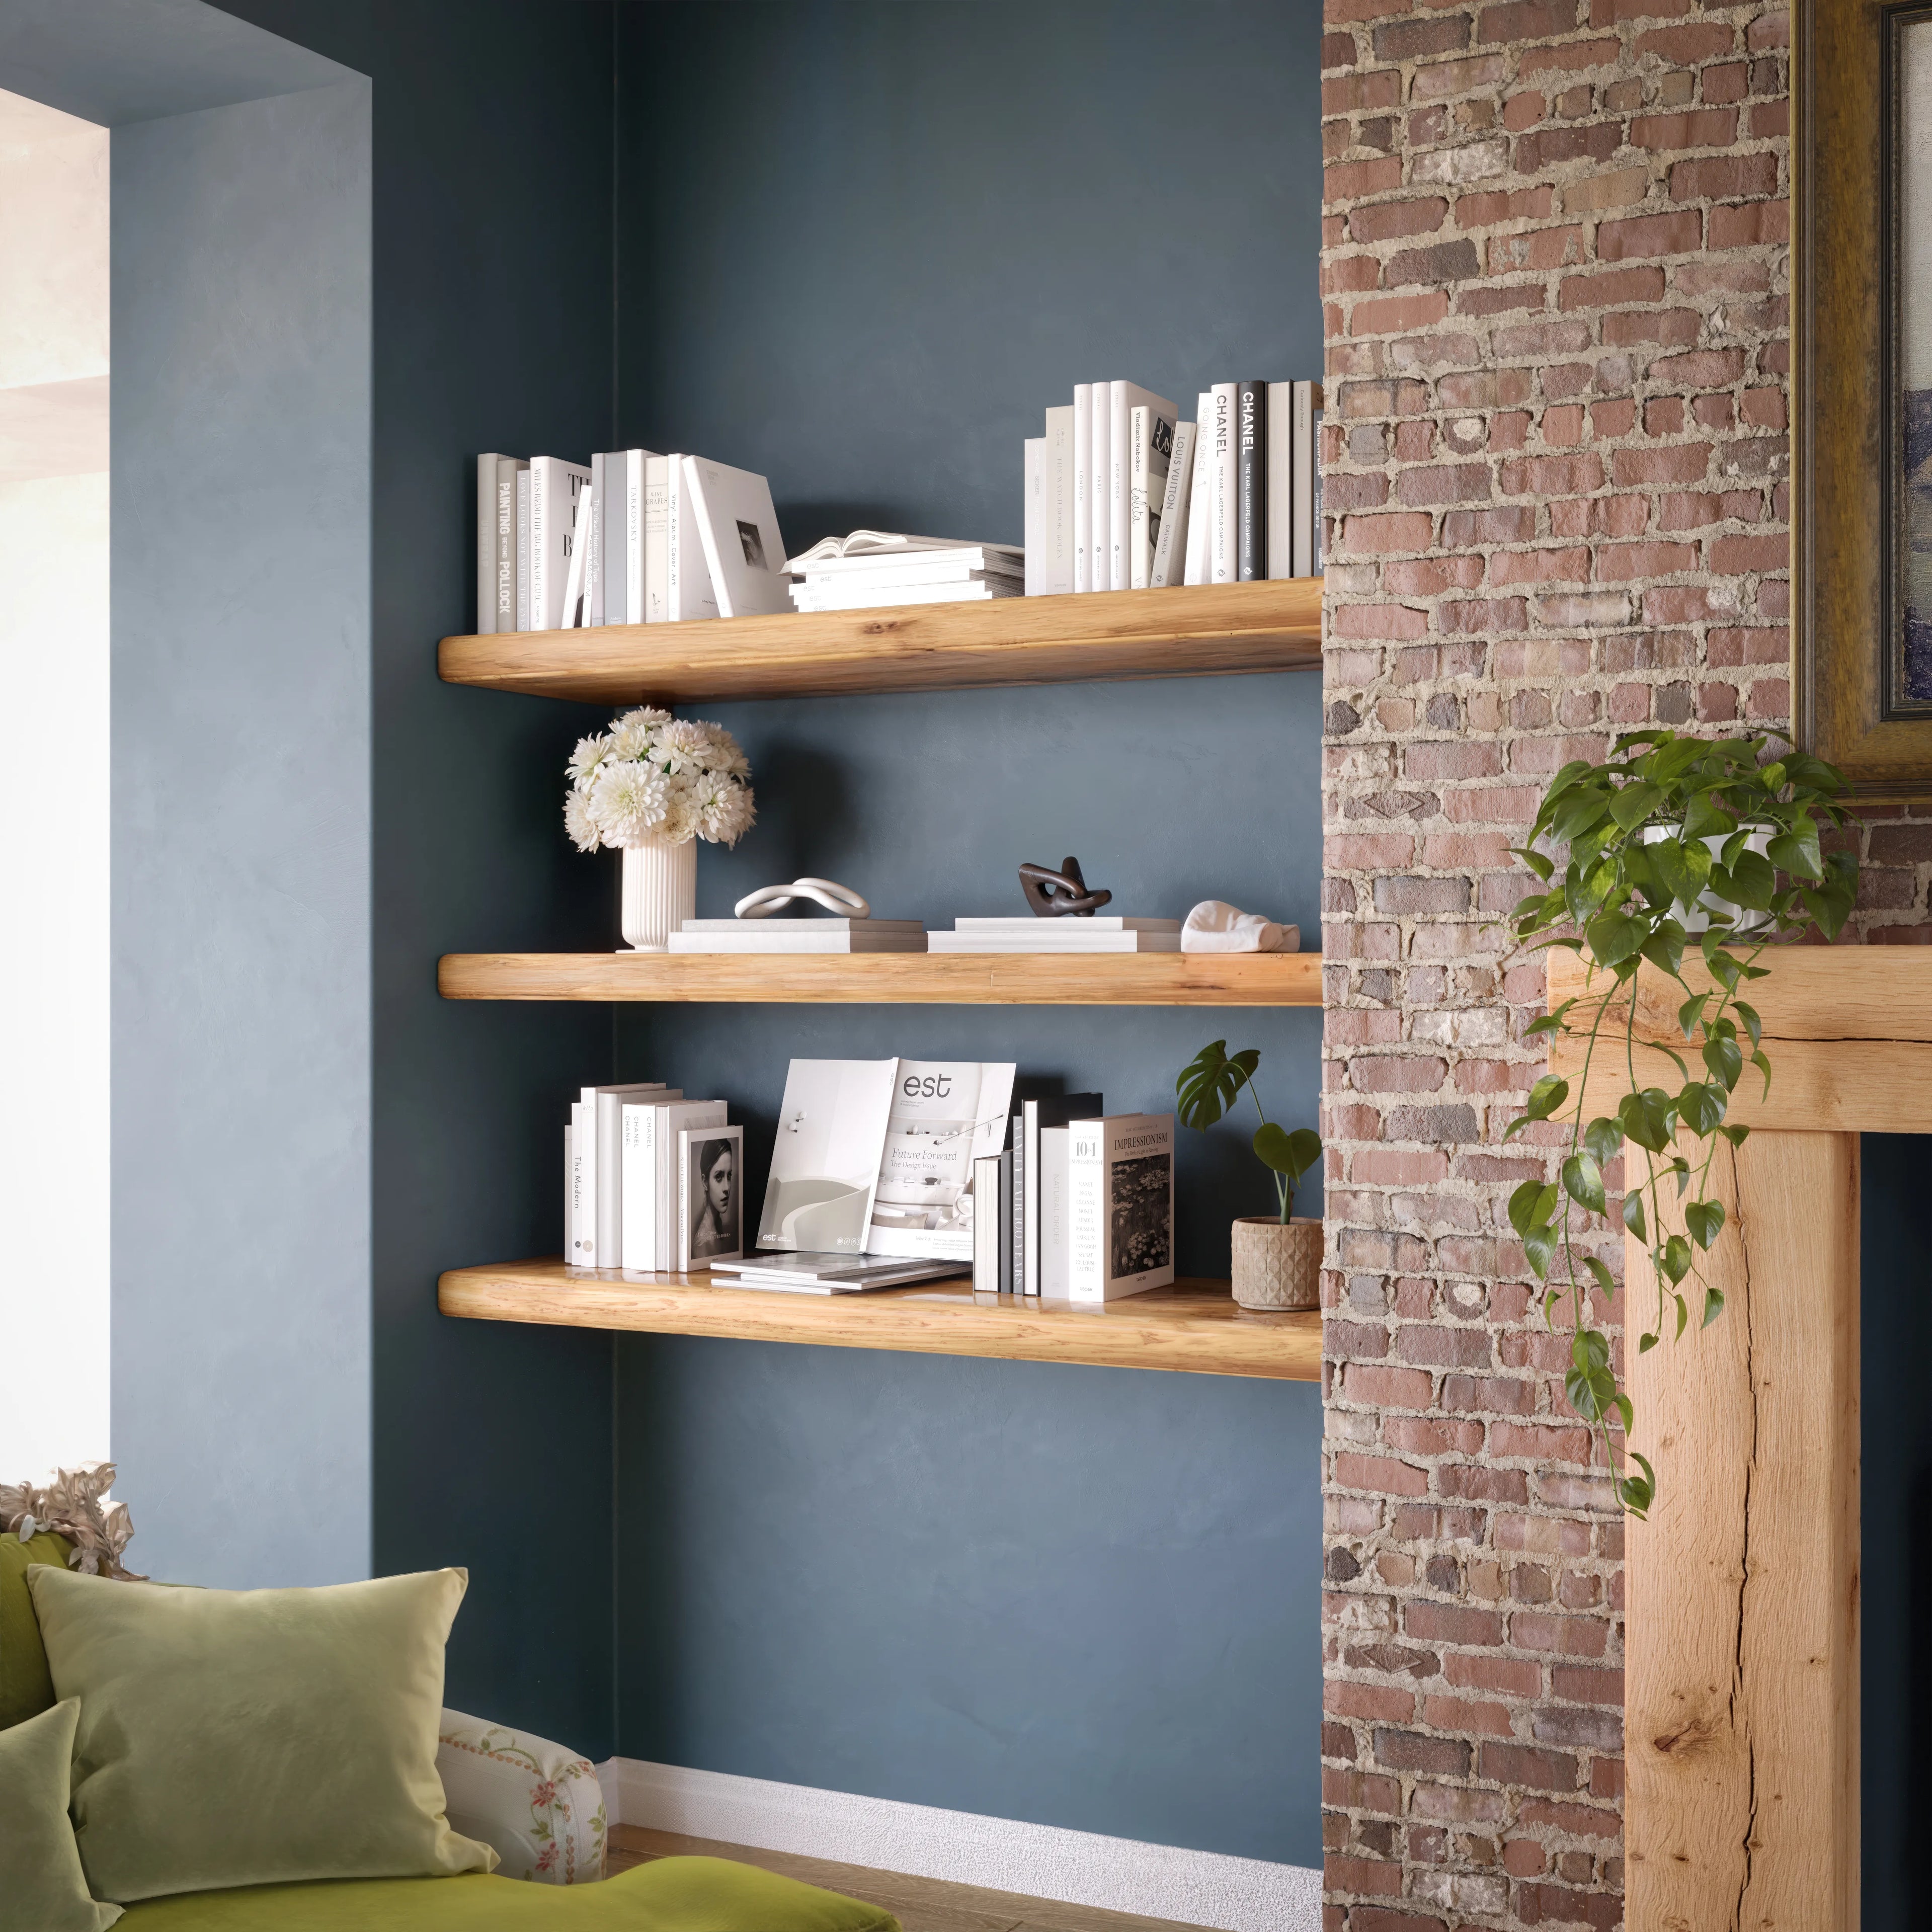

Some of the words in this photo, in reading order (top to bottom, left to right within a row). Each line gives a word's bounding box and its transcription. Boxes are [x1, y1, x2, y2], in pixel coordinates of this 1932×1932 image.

[1157, 421, 1175, 452] Lol
[1201, 408, 1209, 440] GOING
[1217, 394, 1227, 457] CHANEL
[1243, 392, 1254, 455] CHANEL
[1174, 437, 1185, 465] LOUIS
[1198, 445, 1206, 472] ONCE
[1166, 468, 1180, 510] VUITTON
[500, 482, 510, 534] PAINTING
[1131, 488, 1148, 524] Lolita
[1161, 524, 1170, 555] CATWALK
[500, 561, 510, 614] POLLOCK
[534, 572, 541, 582] OF
[904, 1073, 952, 1098] est
[892, 1148, 920, 1159] Future
[922, 1150, 957, 1160] Forward
[1077, 1141, 1087, 1156] 10
[1114, 1133, 1167, 1150] IMPRESSIONISM
[902, 1161, 921, 1170] Design
